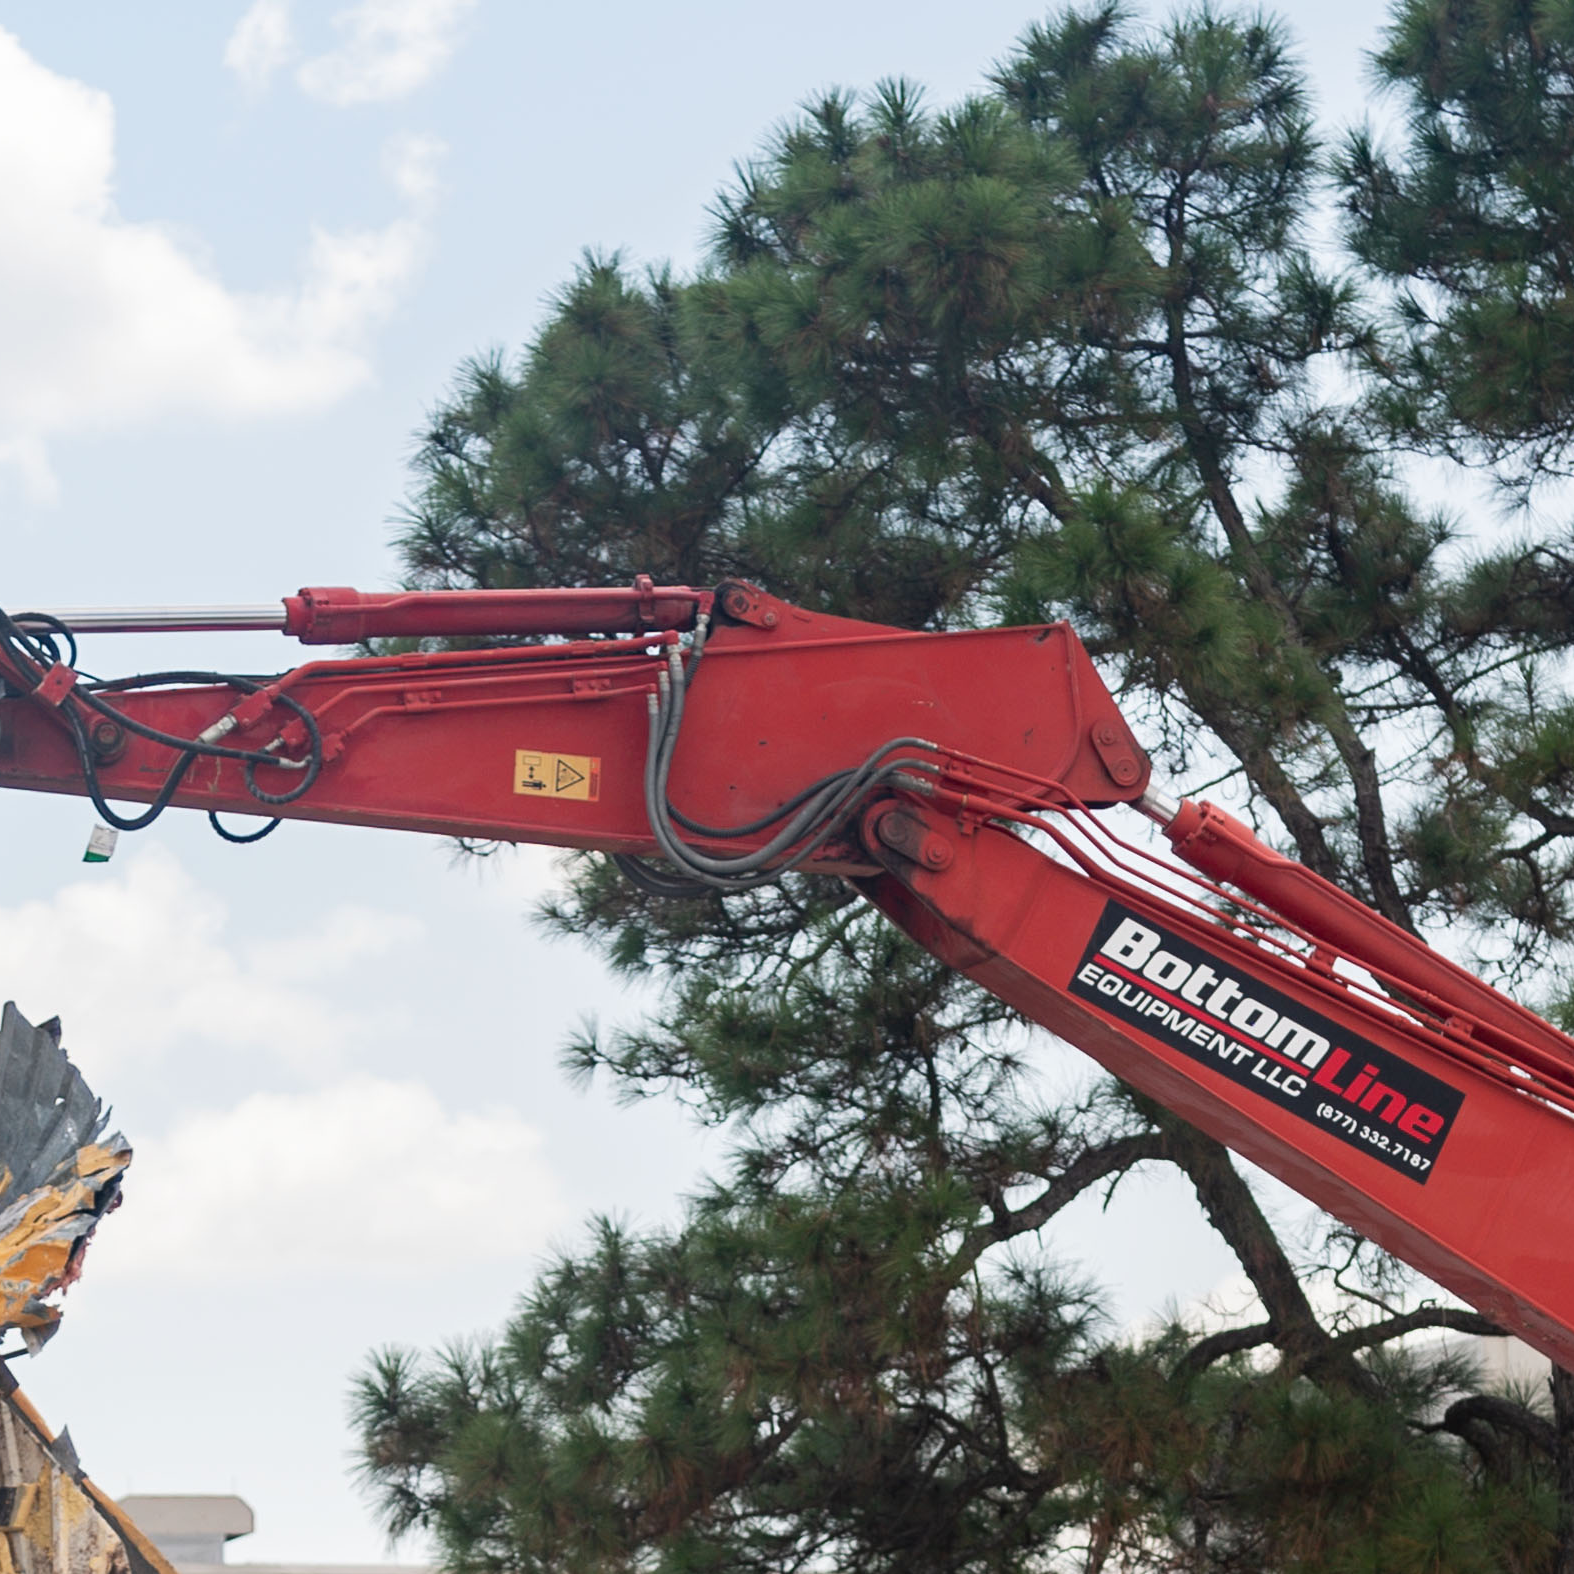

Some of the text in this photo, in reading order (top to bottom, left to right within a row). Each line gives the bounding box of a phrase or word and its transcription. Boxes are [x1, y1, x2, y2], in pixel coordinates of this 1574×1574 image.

[1077, 963, 1307, 1097] EQUIPMENT LLC
[1316, 1102, 1431, 1171] (877) 332.7187
